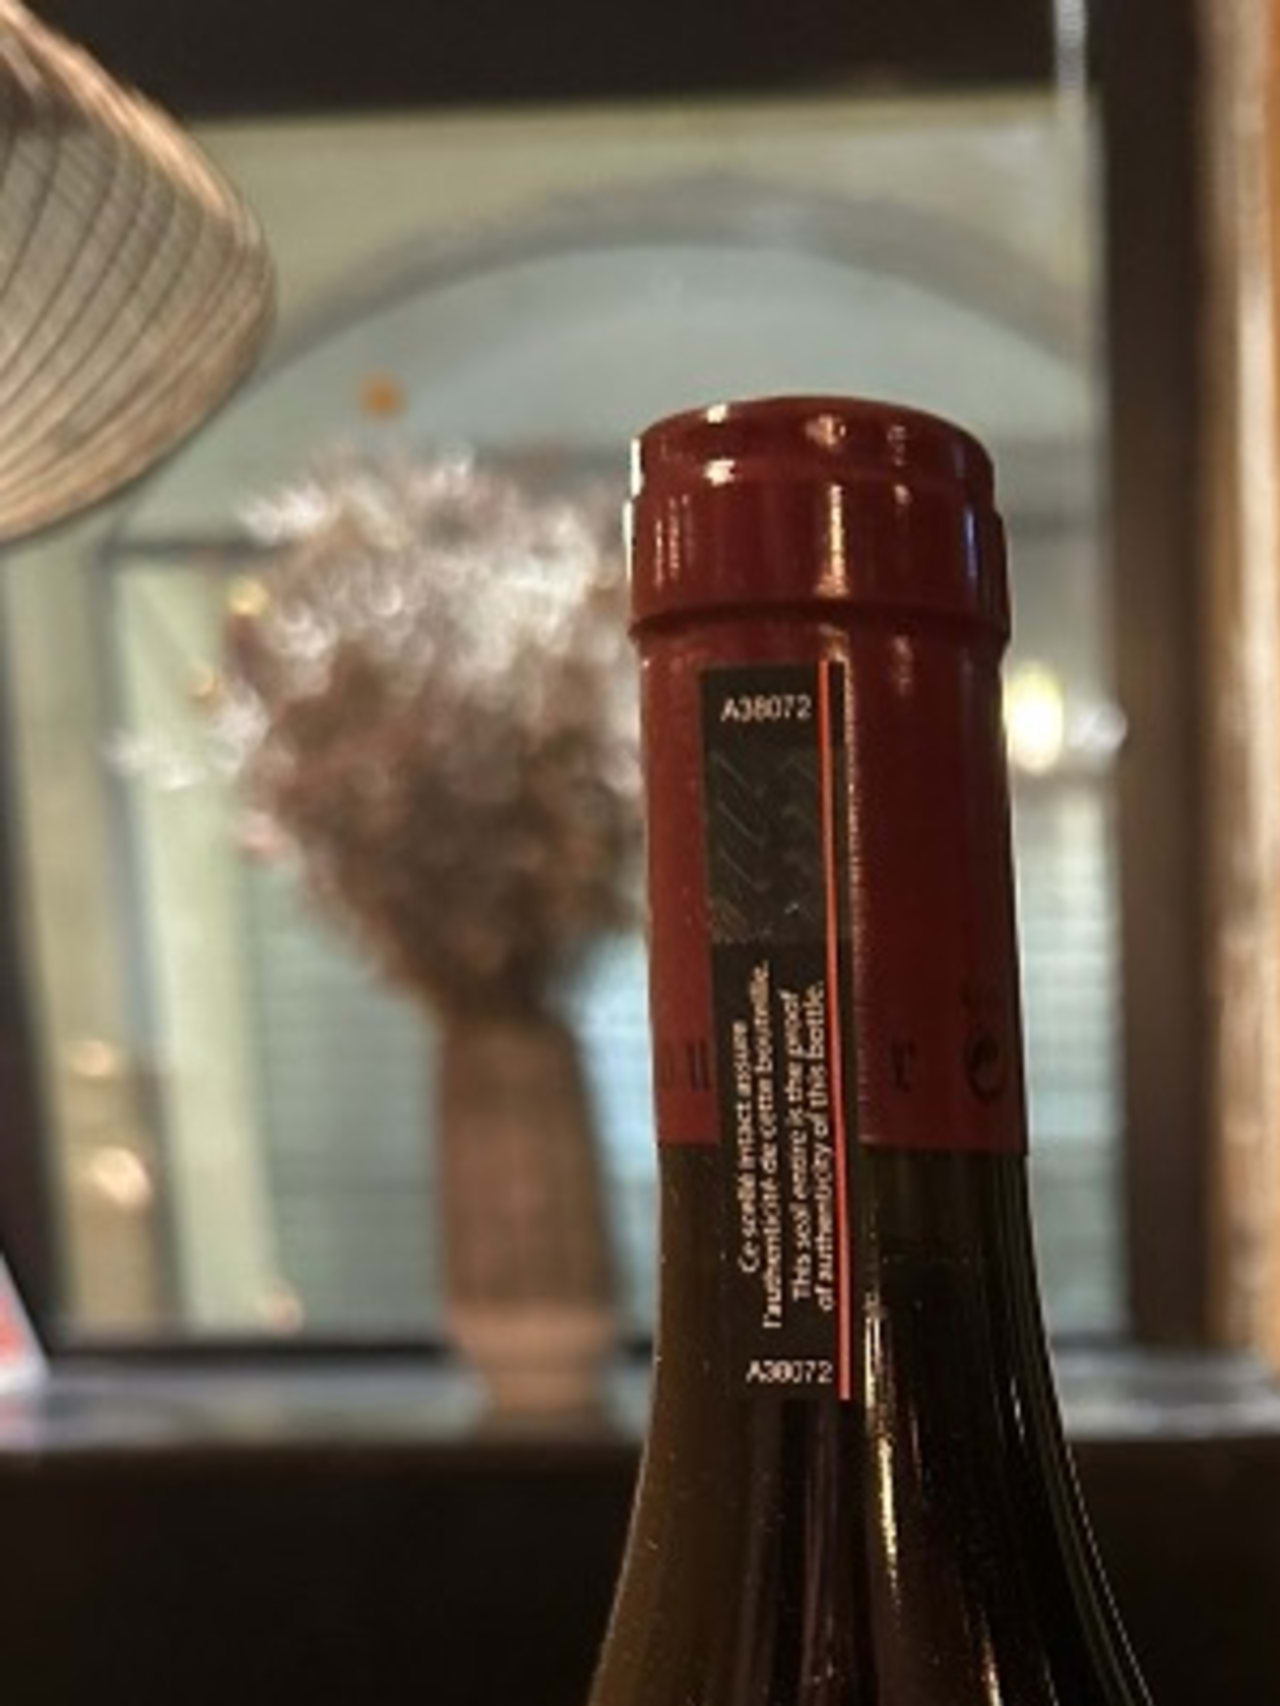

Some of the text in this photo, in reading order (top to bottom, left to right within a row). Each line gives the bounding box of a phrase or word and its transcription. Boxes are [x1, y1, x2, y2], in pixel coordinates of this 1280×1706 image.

[720, 695, 811, 722] A38072
[749, 960, 773, 1073] bouteille.
[732, 1020, 751, 1096] assure
[736, 1102, 756, 1170] intact
[756, 1079, 777, 1139] cette
[761, 1143, 779, 1174] de
[777, 988, 811, 1301] This seal entire is the proof
[802, 980, 834, 1312] of authenticity of this bottle.
[737, 1240, 760, 1273] Ce
[745, 1359, 834, 1384] A38072
